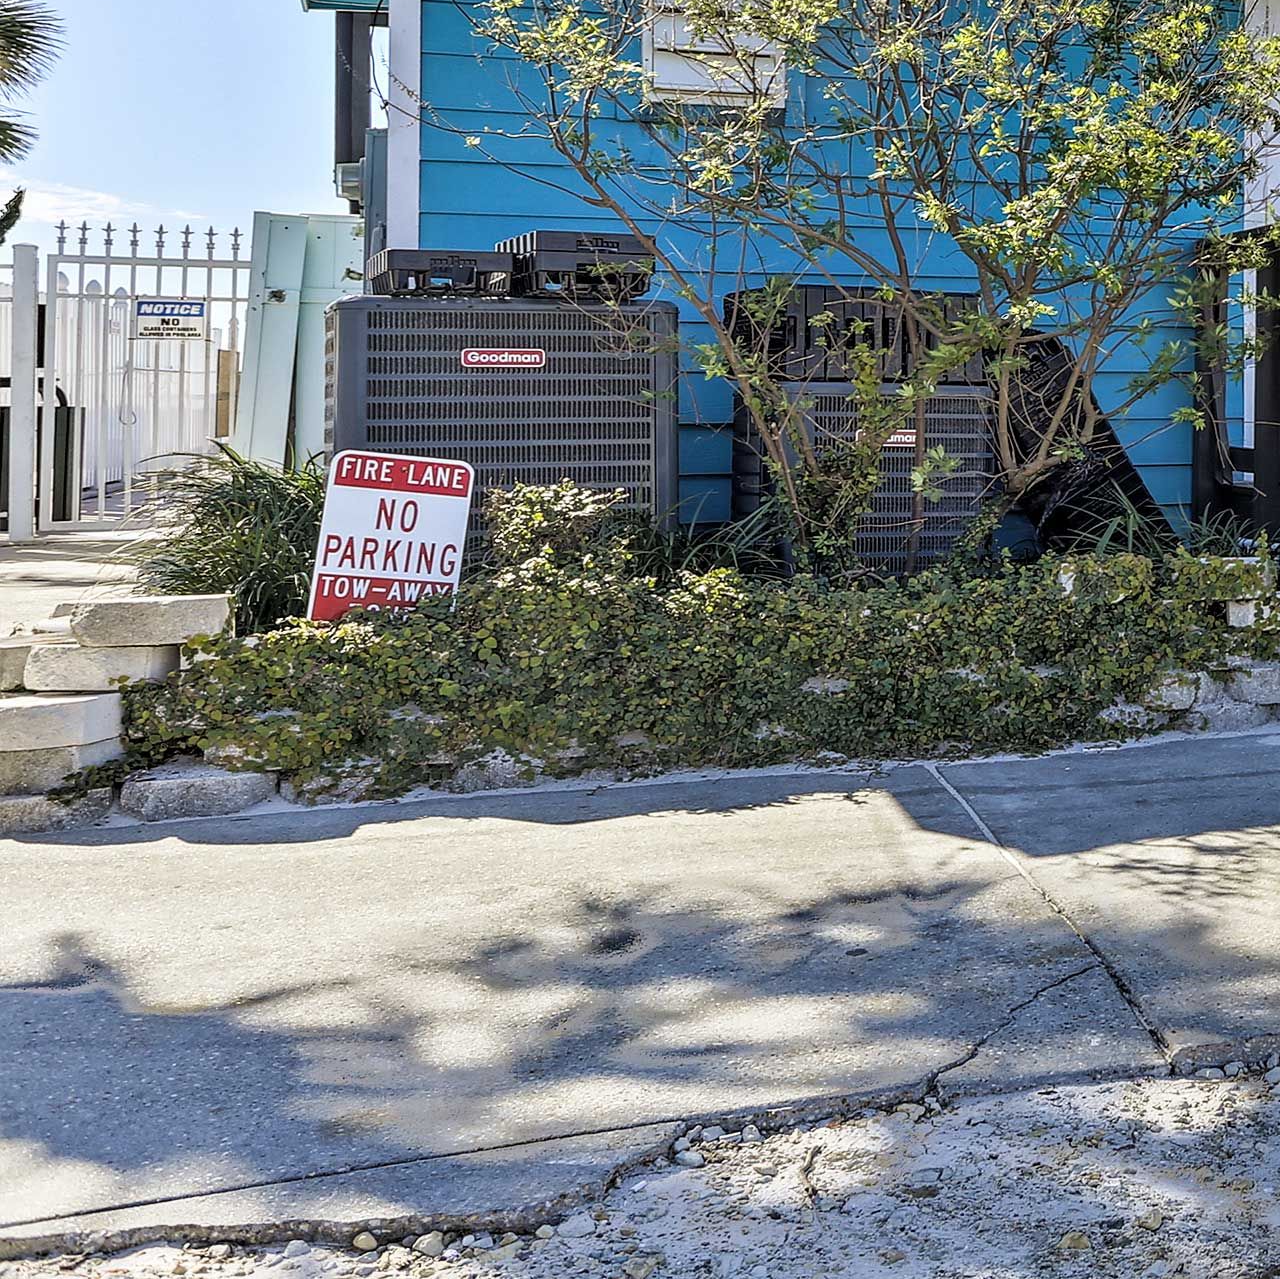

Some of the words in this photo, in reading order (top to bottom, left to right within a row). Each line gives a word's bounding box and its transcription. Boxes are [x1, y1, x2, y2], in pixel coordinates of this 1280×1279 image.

[140, 303, 202, 315] NOTICE
[160, 318, 180, 326] NO
[467, 352, 540, 363] Goodman
[341, 457, 394, 482] FIRE
[407, 463, 466, 489] LANE
[375, 498, 419, 533] NO
[321, 534, 457, 577] PARKING
